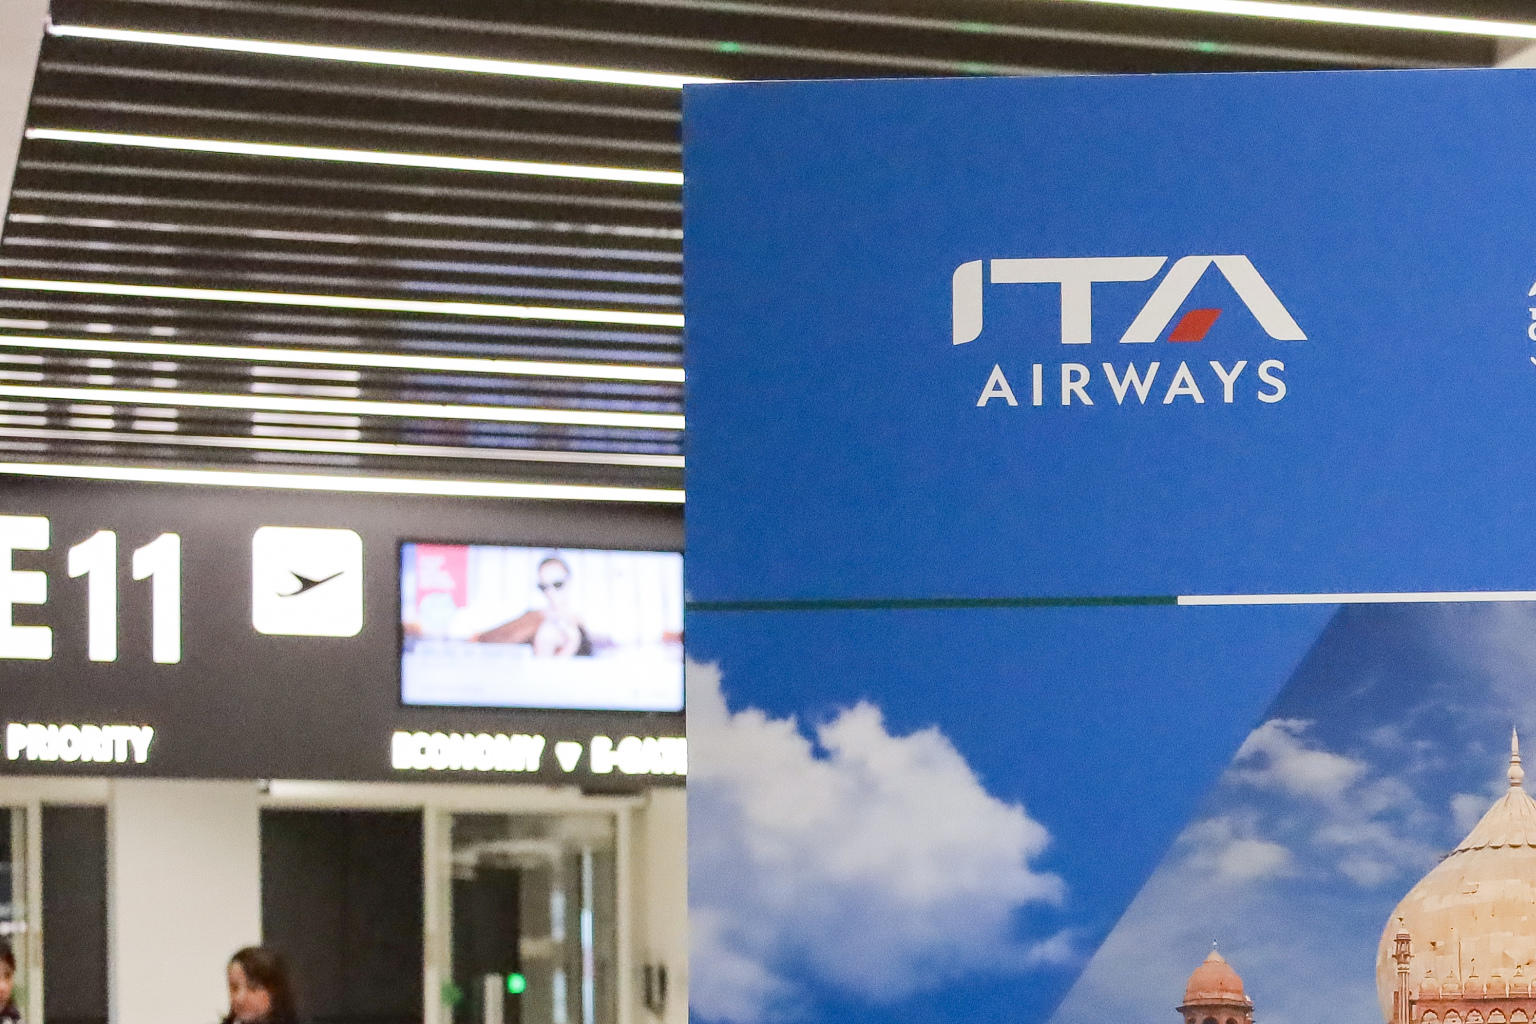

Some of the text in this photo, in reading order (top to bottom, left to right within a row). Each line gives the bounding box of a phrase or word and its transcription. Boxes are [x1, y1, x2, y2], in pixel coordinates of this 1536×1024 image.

[952, 255, 1308, 345] ITA
[976, 359, 1288, 407] AIRWAYS
[0, 514, 182, 664] E11
[6, 722, 155, 764] PRIORITY
[391, 731, 546, 773] ECONOMY
